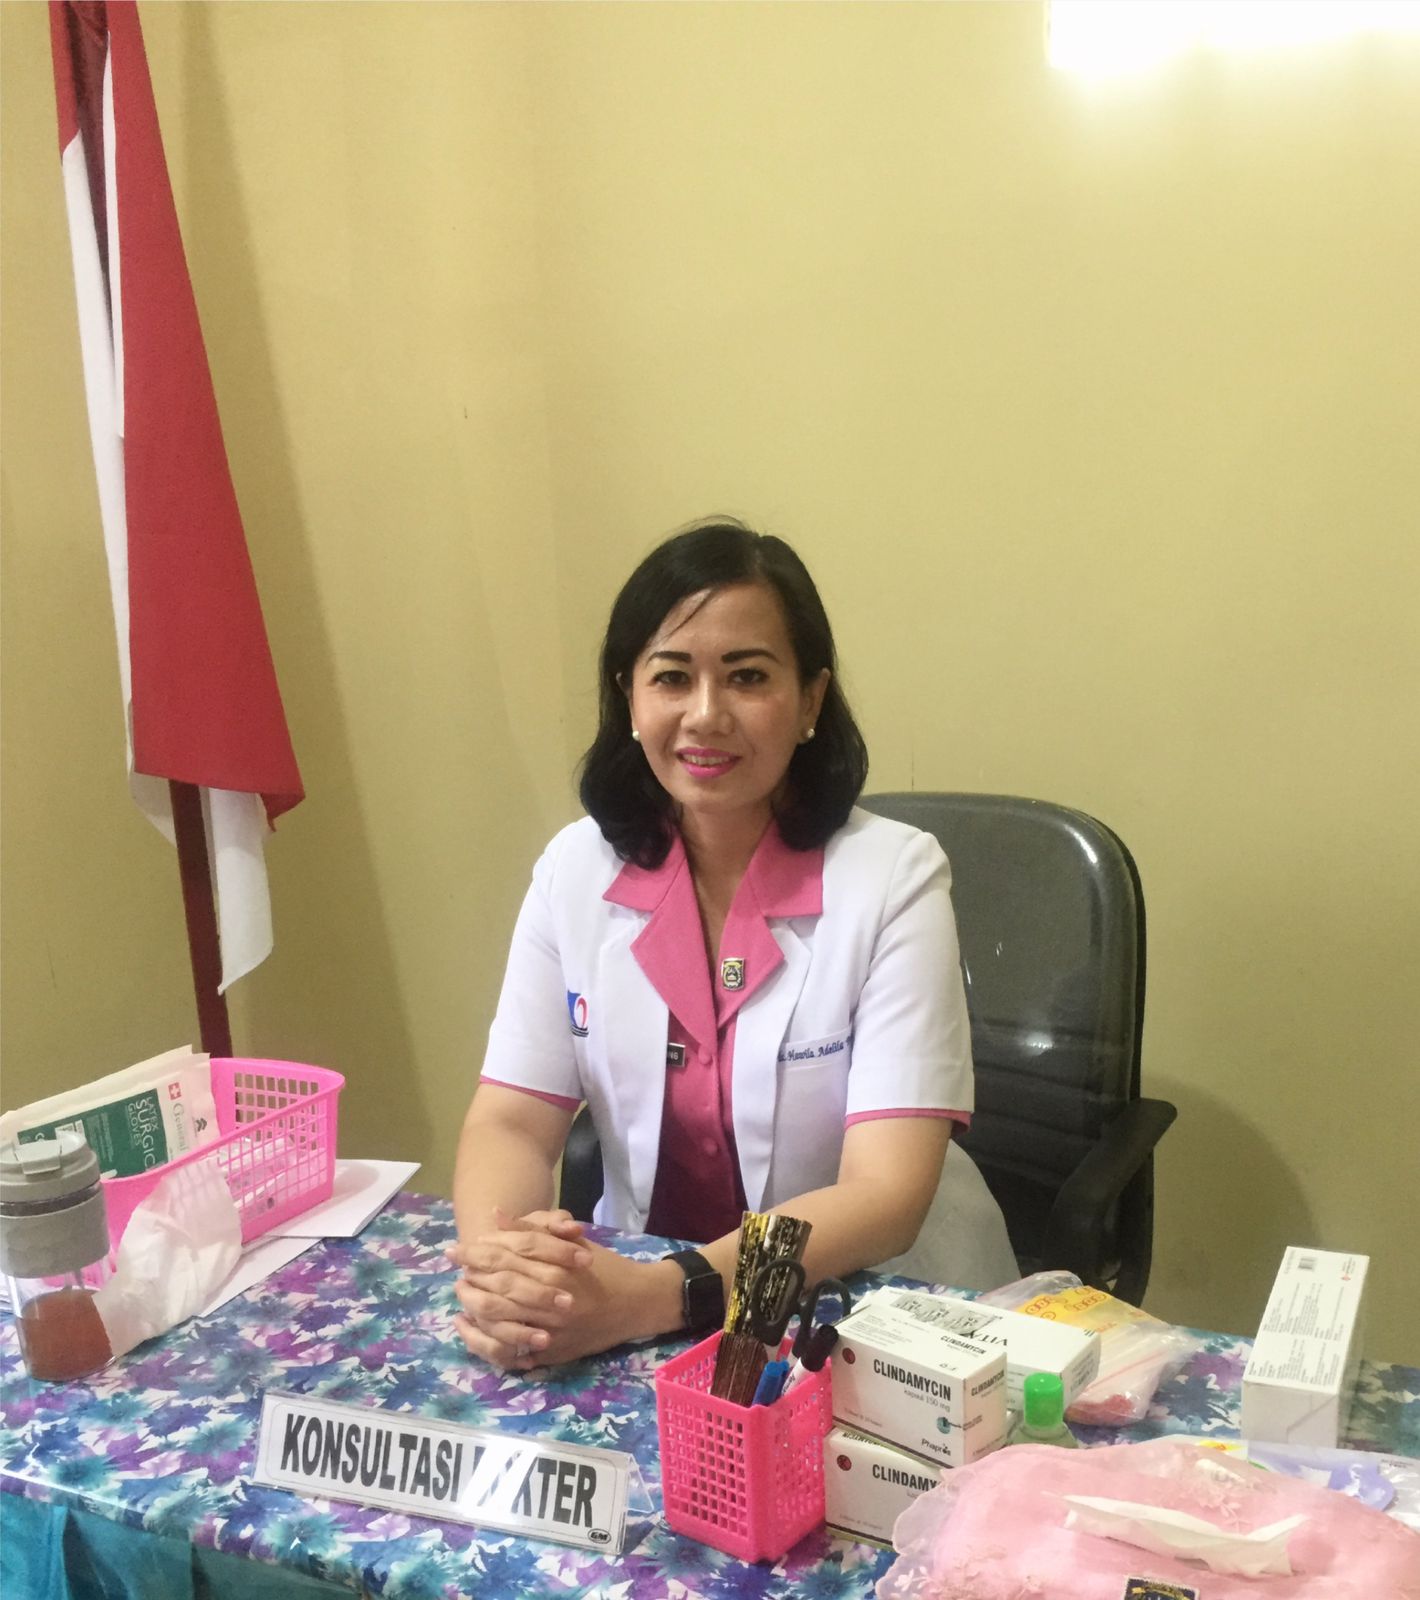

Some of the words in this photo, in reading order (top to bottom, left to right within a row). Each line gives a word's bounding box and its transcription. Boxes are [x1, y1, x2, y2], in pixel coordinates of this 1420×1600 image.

[127, 1103, 142, 1146] GLOVES
[145, 1096, 160, 1131] LATEX
[940, 1335, 987, 1355] CLINDAMYCIN
[873, 1358, 952, 1402] CLINDAMYCIN
[280, 1413, 464, 1503] KONSULTASI
[471, 1445, 597, 1528] KTER
[872, 1463, 940, 1492] CLINDAMY
